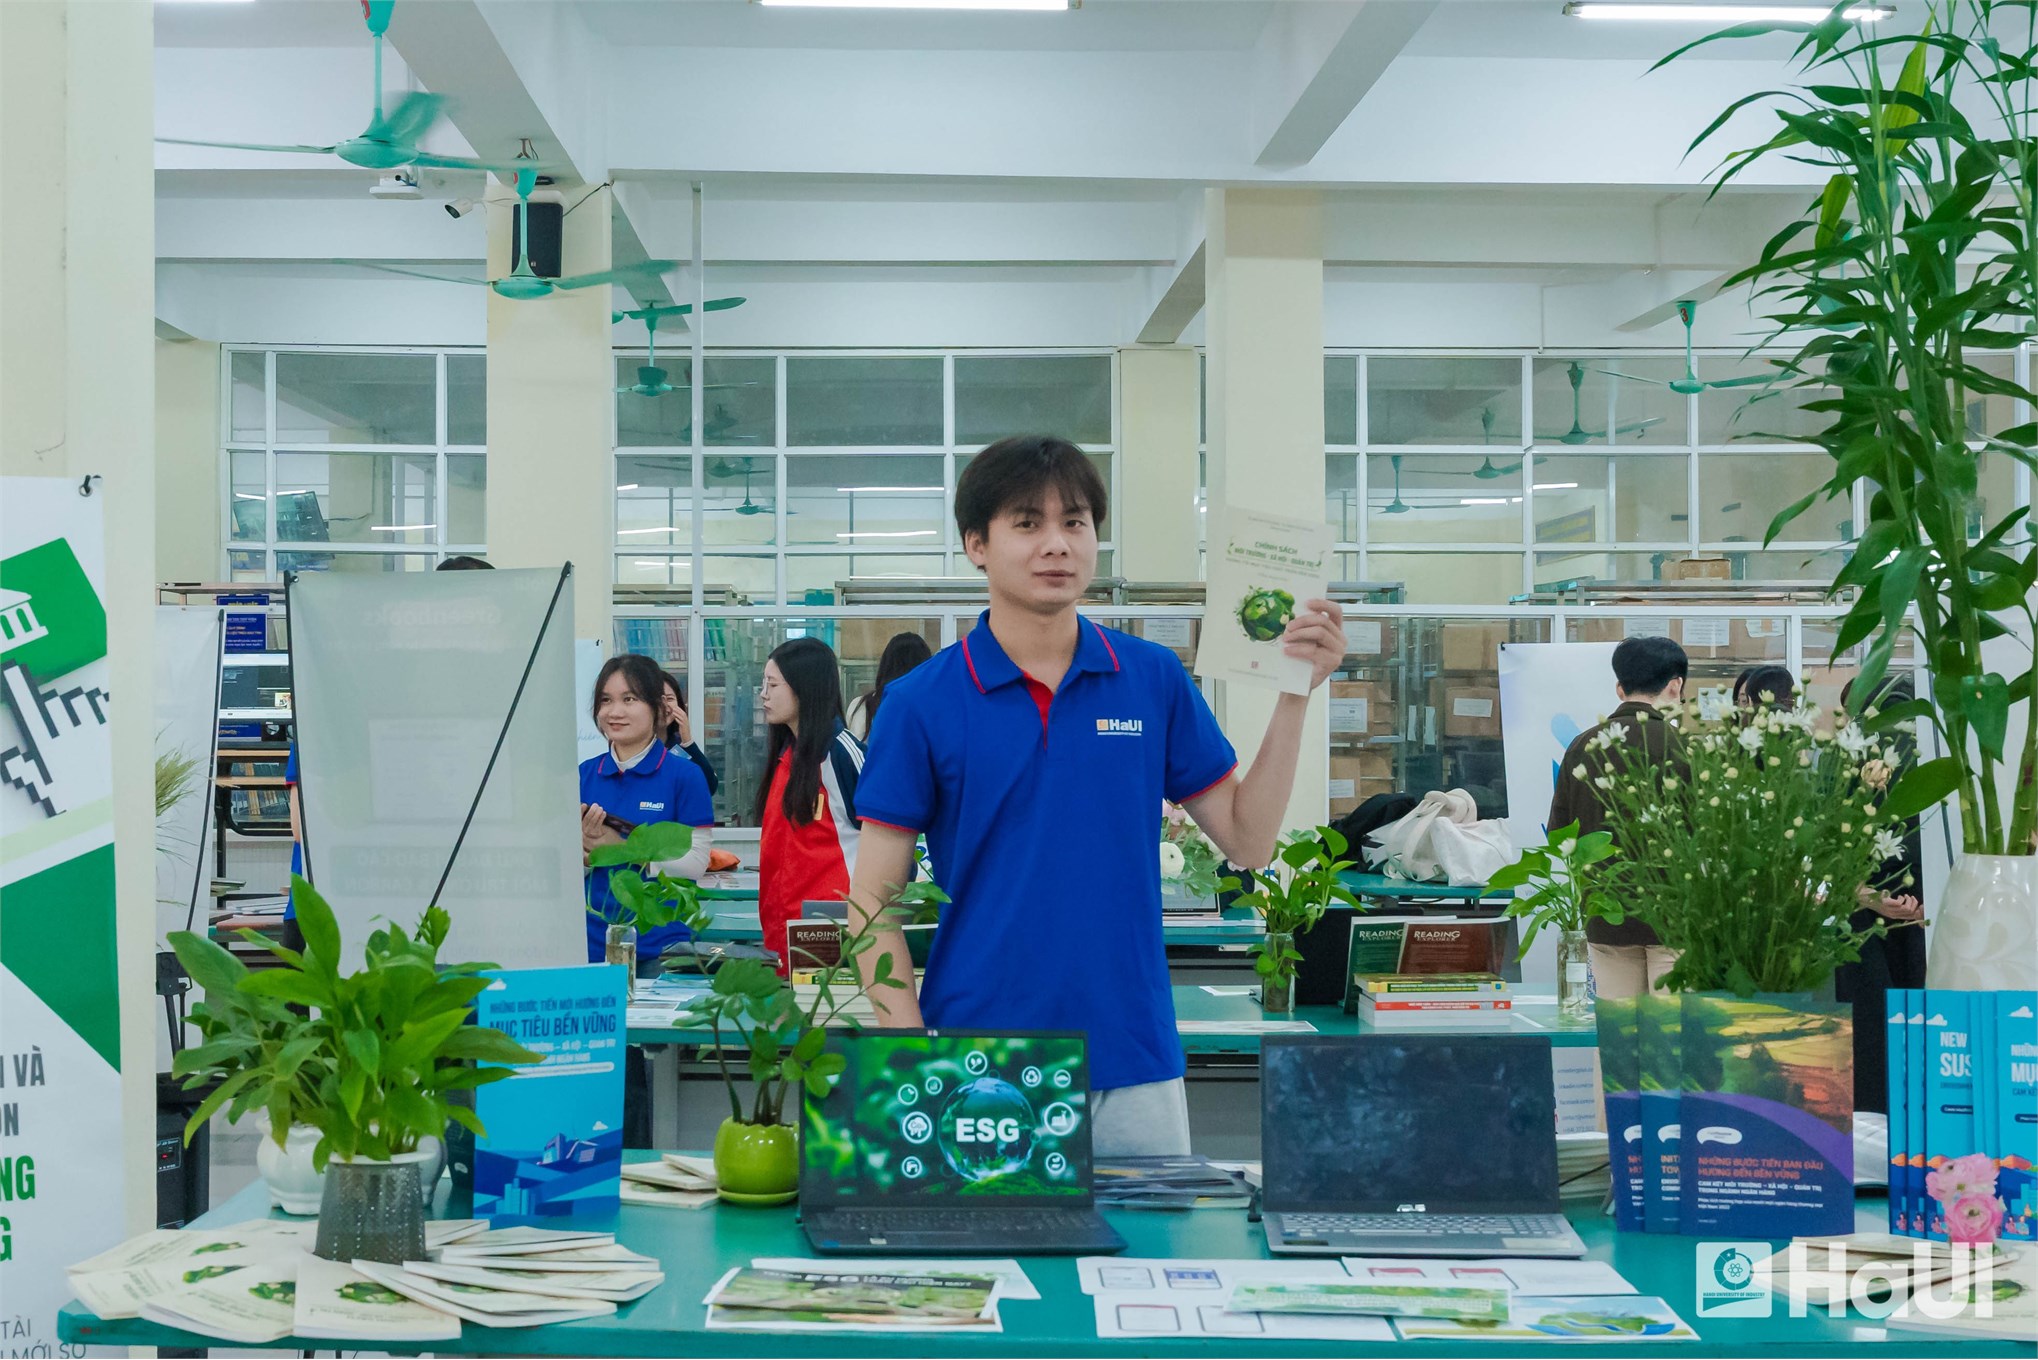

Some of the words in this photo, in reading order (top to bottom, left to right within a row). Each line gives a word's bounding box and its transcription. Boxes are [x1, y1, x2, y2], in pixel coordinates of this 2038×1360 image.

[521, 1014, 550, 1038] TIÊU
[1940, 1031, 1968, 1048] NEW
[13, 1044, 46, 1087] VÀ
[956, 1117, 1020, 1143] ESG
[0, 1314, 31, 1340] TÀI
